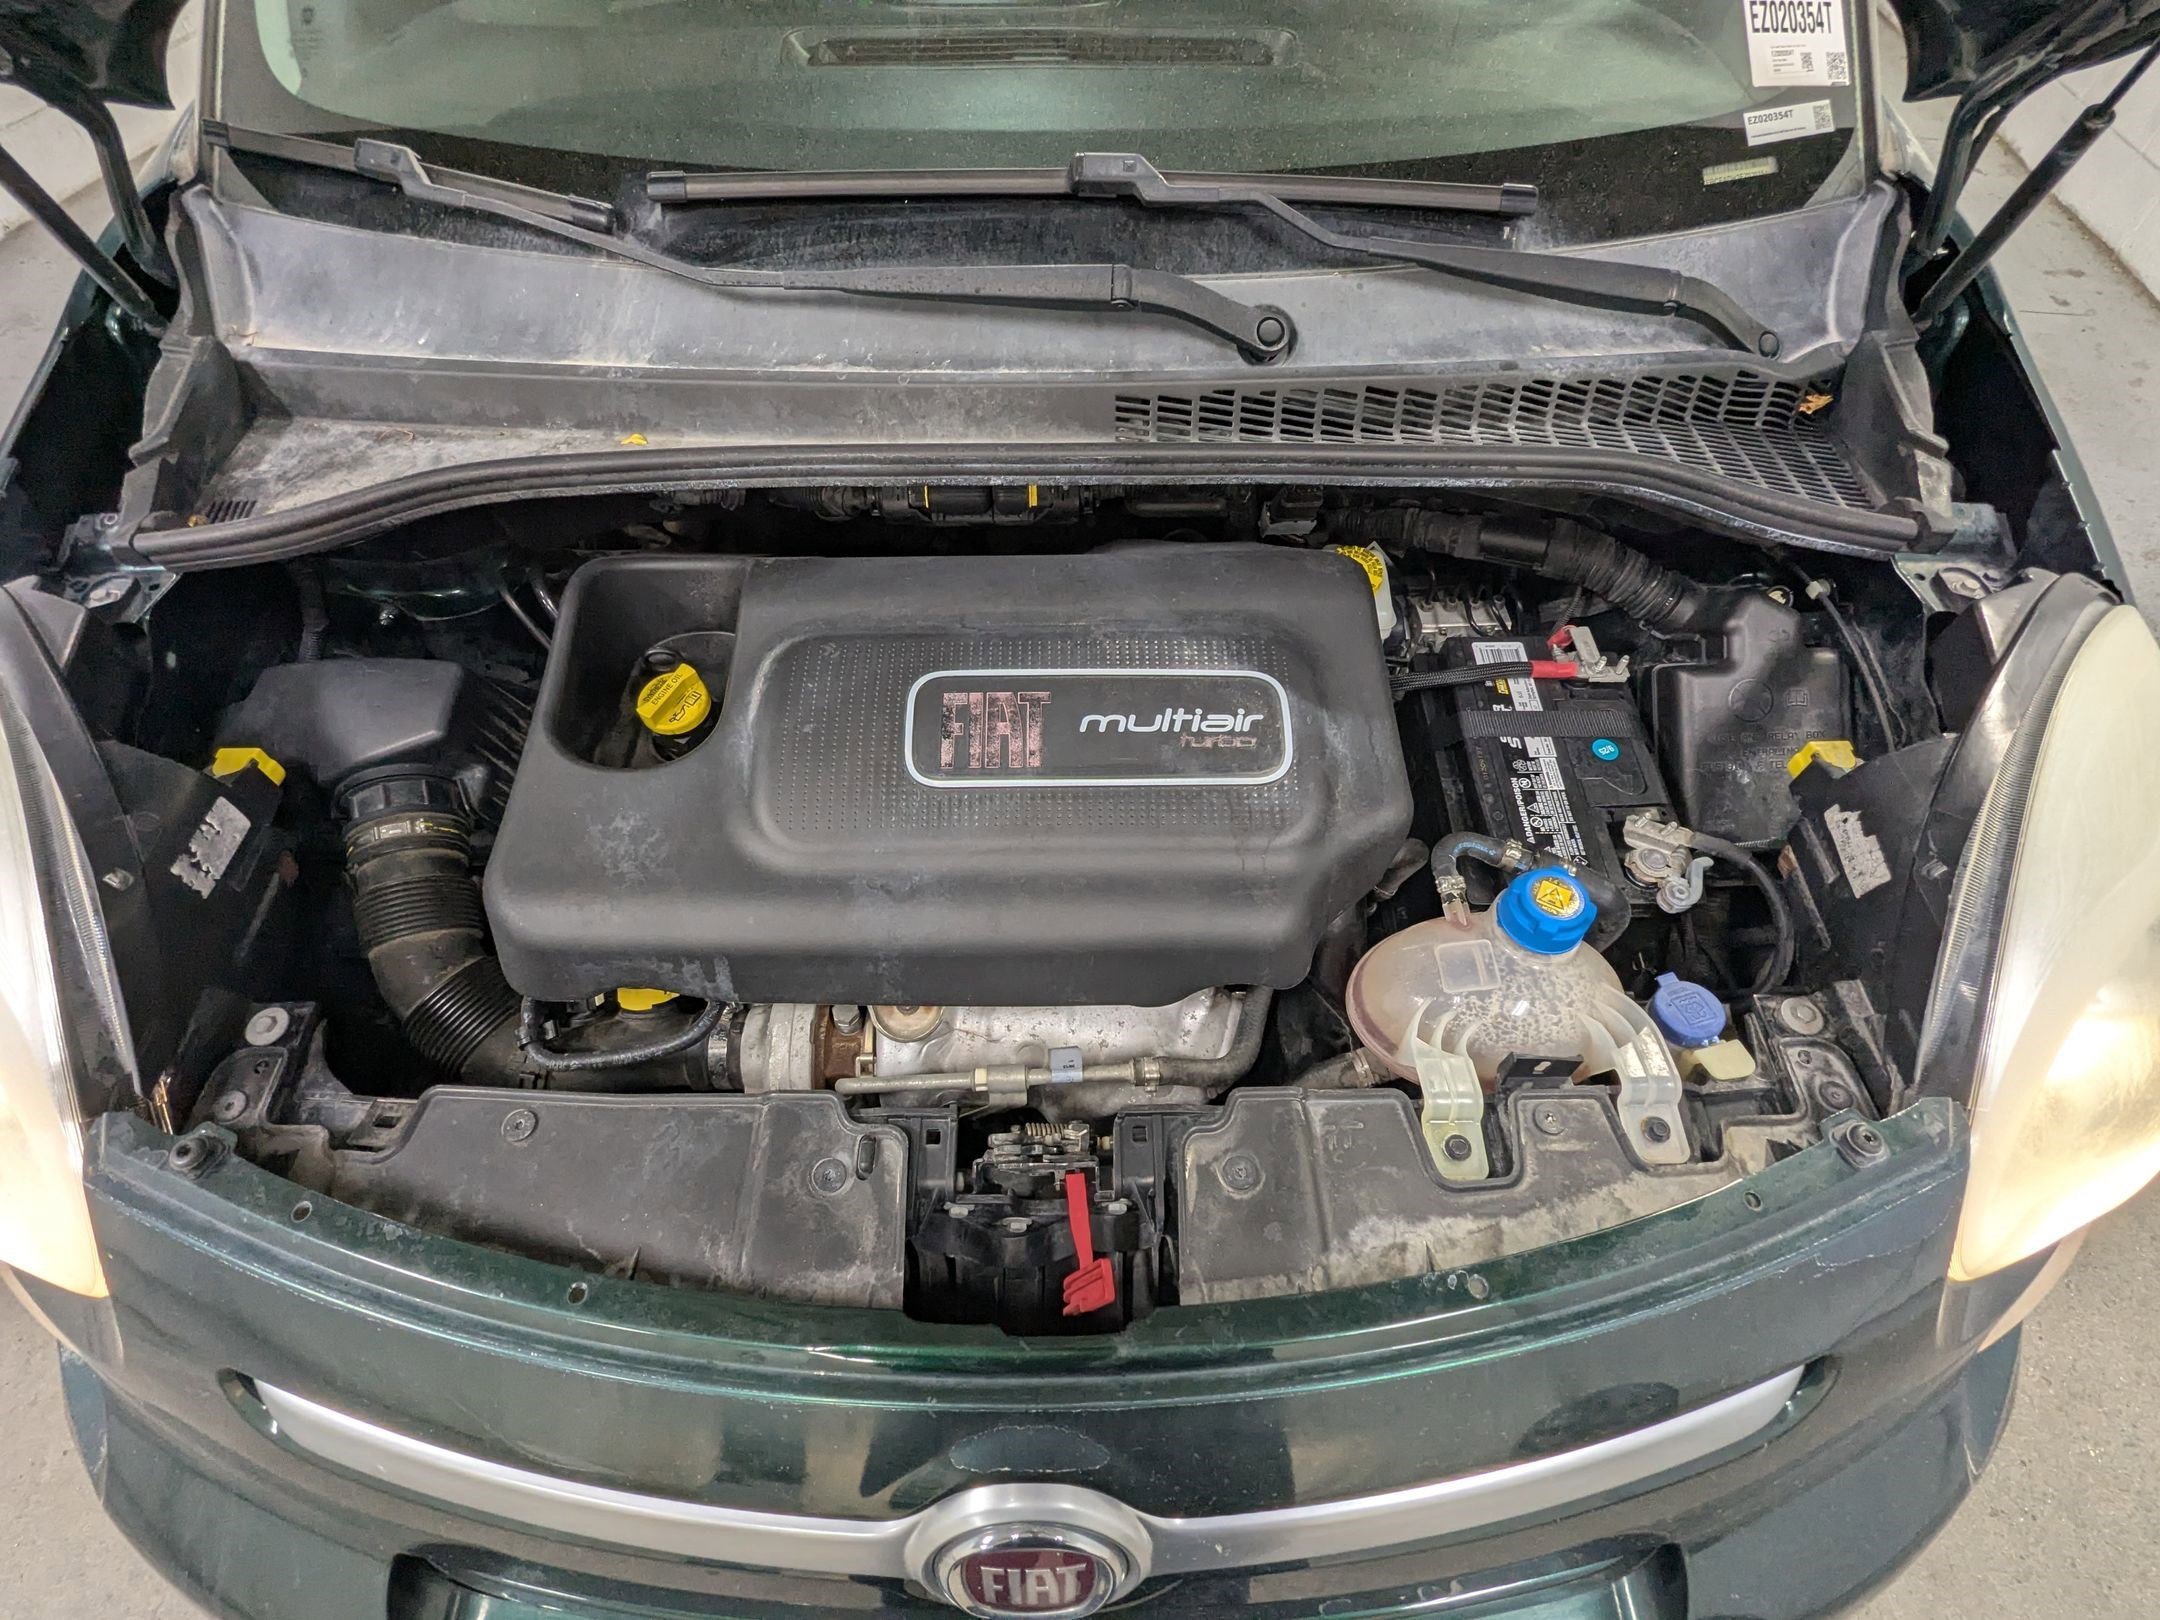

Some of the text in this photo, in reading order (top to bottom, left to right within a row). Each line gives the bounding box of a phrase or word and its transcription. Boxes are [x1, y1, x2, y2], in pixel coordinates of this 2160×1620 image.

[1751, 1, 1832, 34] EZ020354T
[1747, 109, 1793, 126] EZ020354T
[651, 682, 674, 705] ENGINE
[671, 673, 682, 683] OIL
[940, 691, 1051, 769] FIAT
[1080, 708, 1264, 733] multiair
[1806, 730, 1825, 740] BOX
[1180, 733, 1258, 750] turbo
[1510, 777, 1533, 838] DANGER/POISON
[980, 1562, 1087, 1605] FIAT
